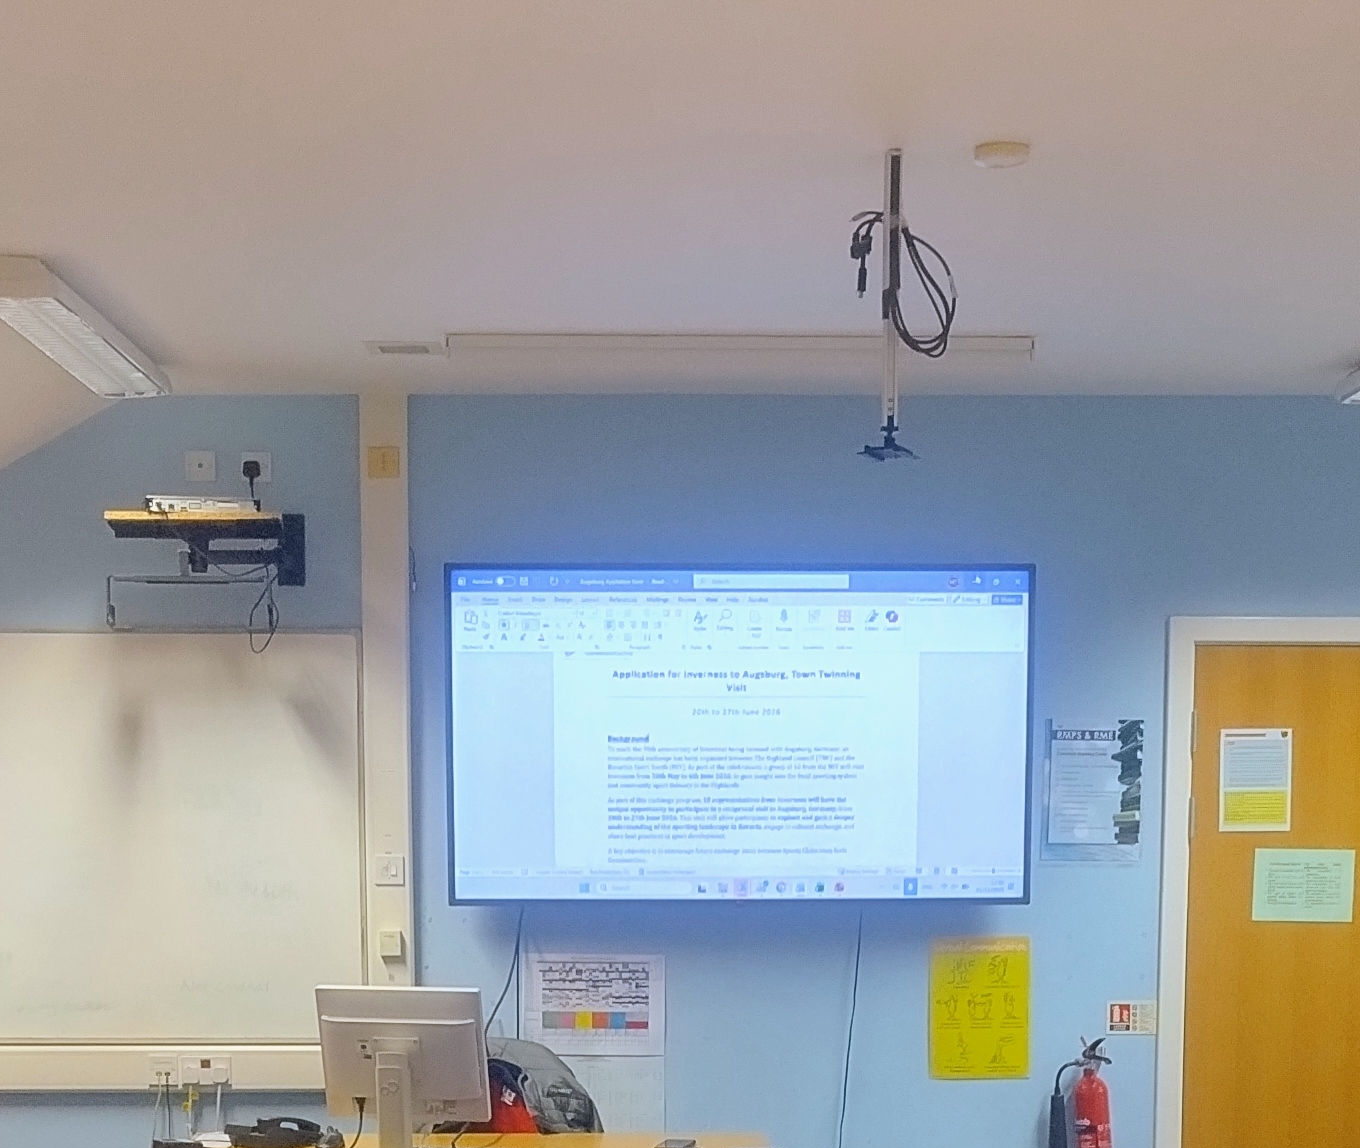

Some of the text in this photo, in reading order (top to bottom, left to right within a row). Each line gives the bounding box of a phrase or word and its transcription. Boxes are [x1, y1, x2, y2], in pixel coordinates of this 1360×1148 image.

[612, 669, 860, 680] Application for Inverness to Augsburg, Town Twinning
[726, 684, 747, 692] Visit
